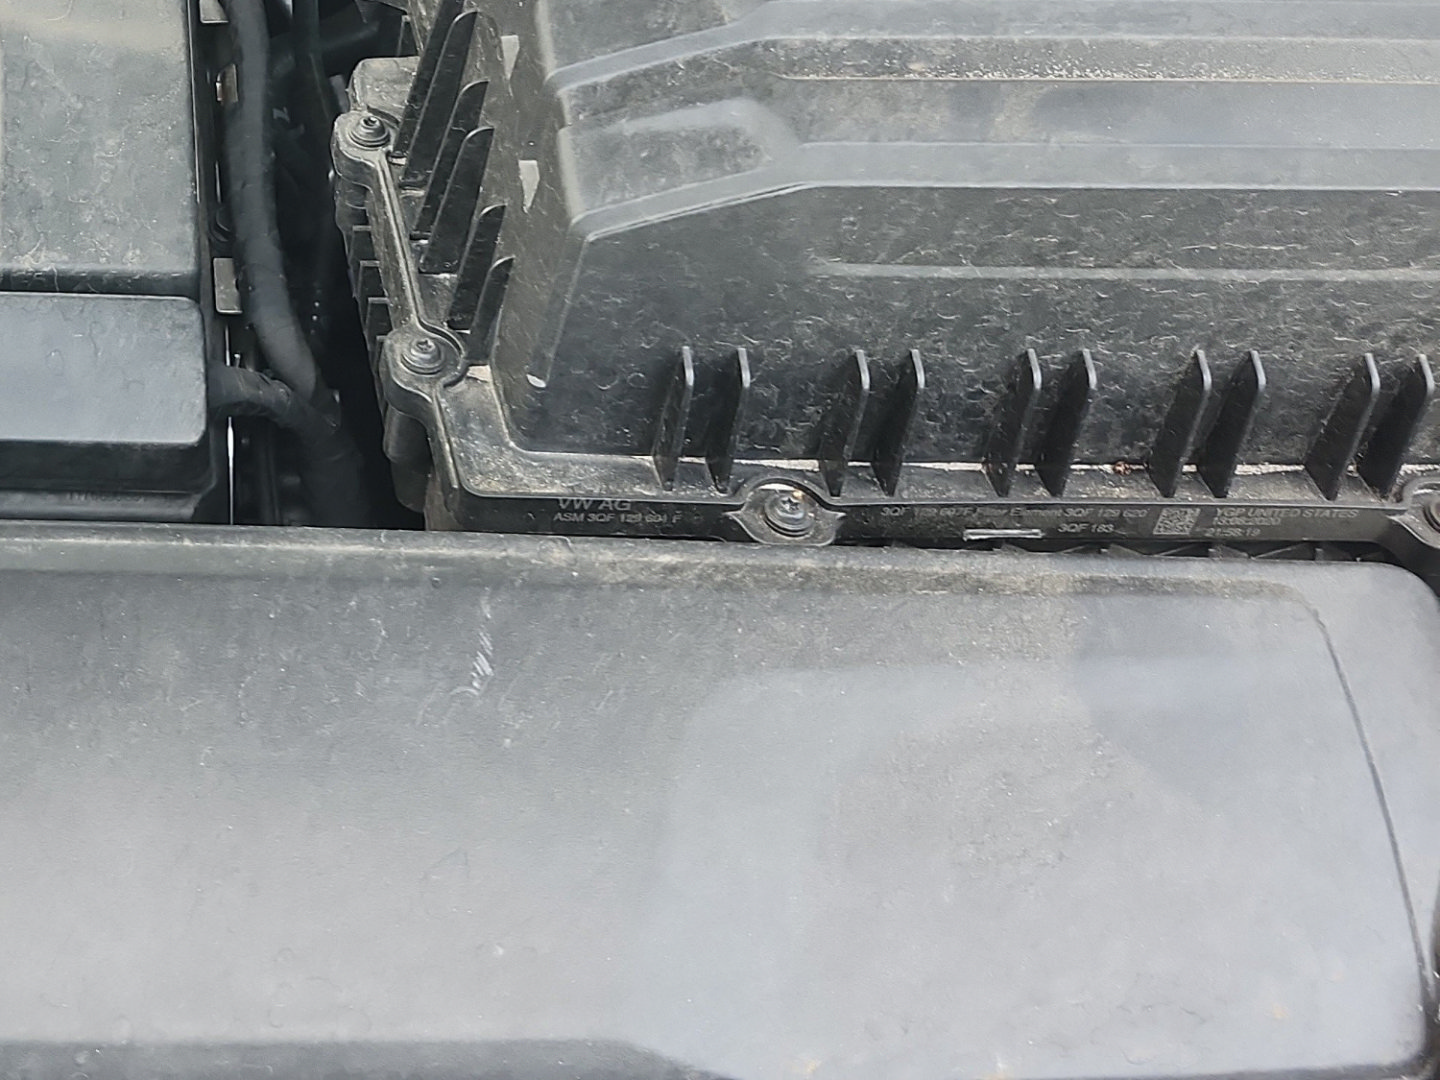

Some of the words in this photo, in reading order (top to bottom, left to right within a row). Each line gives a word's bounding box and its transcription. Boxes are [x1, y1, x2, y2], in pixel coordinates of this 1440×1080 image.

[558, 499, 592, 511] VW
[602, 500, 632, 512] AG
[1248, 508, 1301, 519] UNITED
[1302, 509, 1360, 519] STATES
